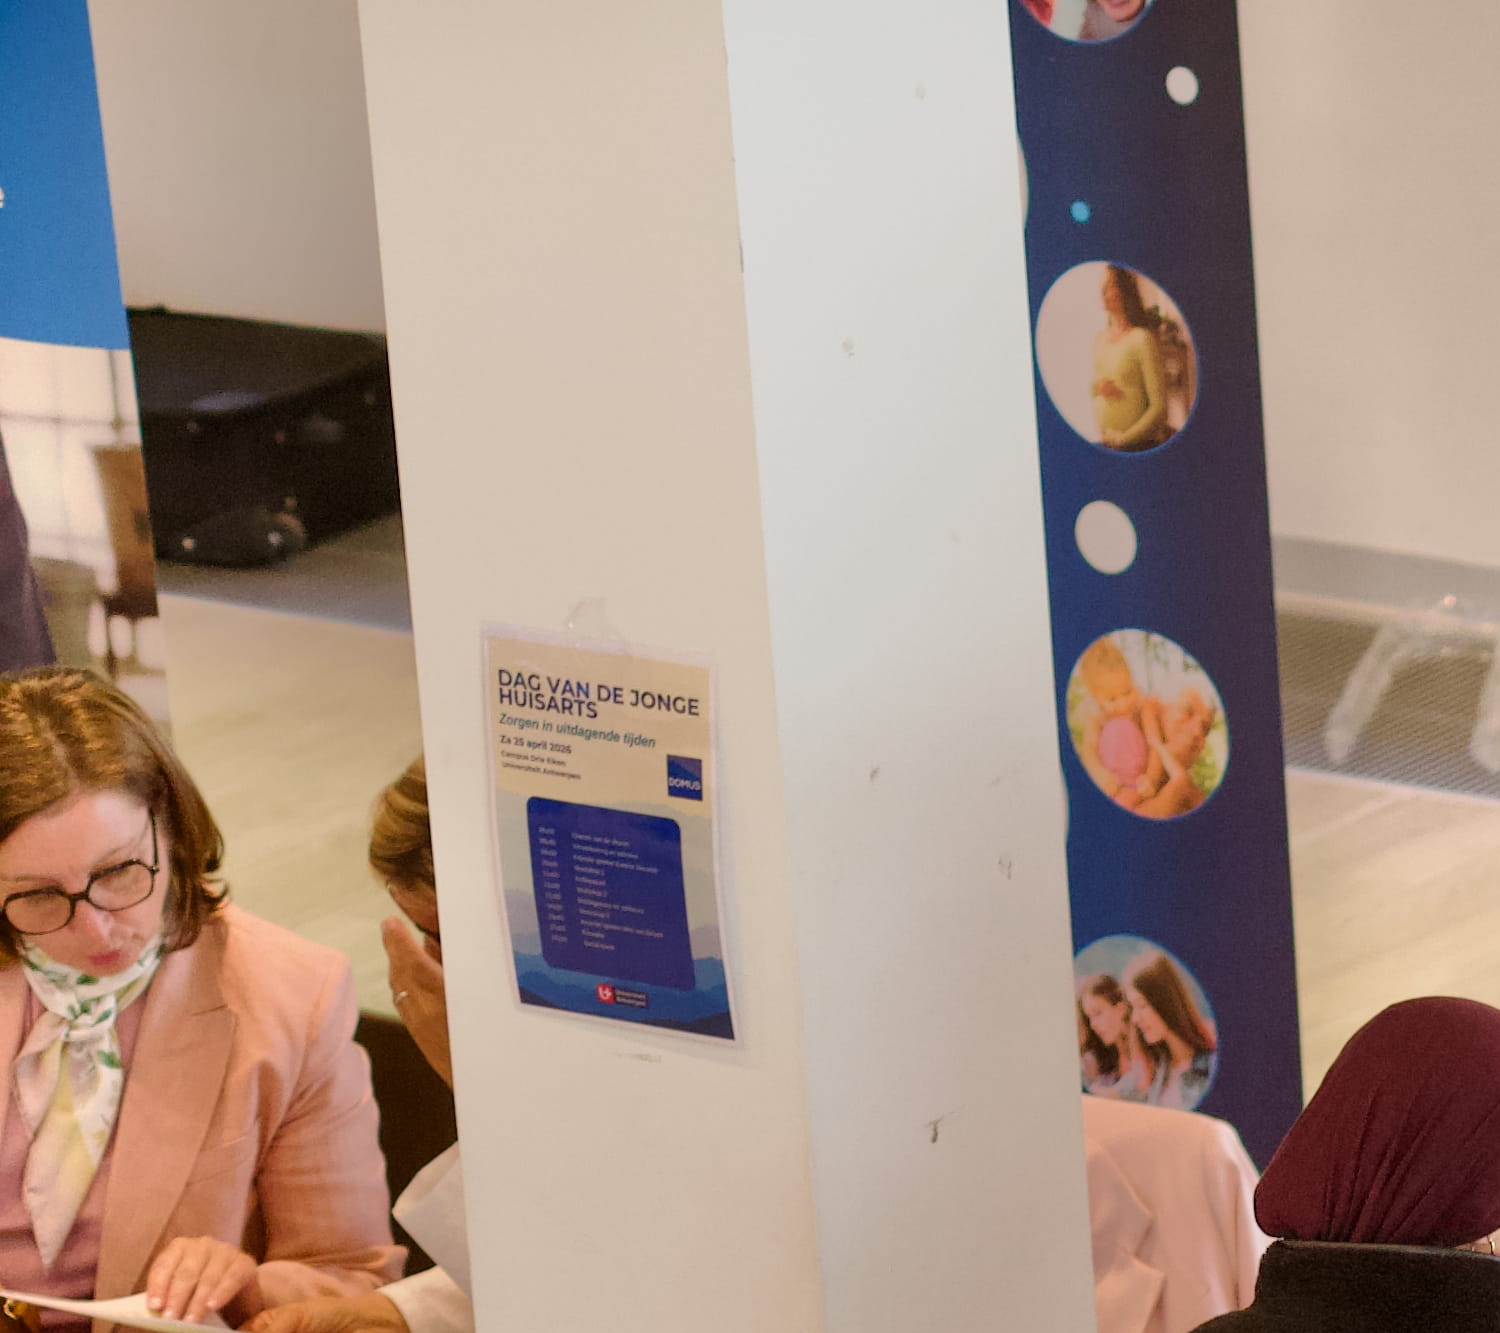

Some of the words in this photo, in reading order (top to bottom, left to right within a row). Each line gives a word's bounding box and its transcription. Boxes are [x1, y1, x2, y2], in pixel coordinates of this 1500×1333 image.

[498, 669, 541, 691] DAG
[547, 676, 590, 699] VAN
[597, 684, 625, 705] DE
[630, 689, 700, 716] JONGE
[499, 688, 598, 719] HUISARTS
[499, 713, 540, 731] Zorgen
[543, 717, 553, 731] in
[556, 721, 621, 744] uitdagende
[624, 734, 656, 749] tijden
[527, 738, 548, 752] april
